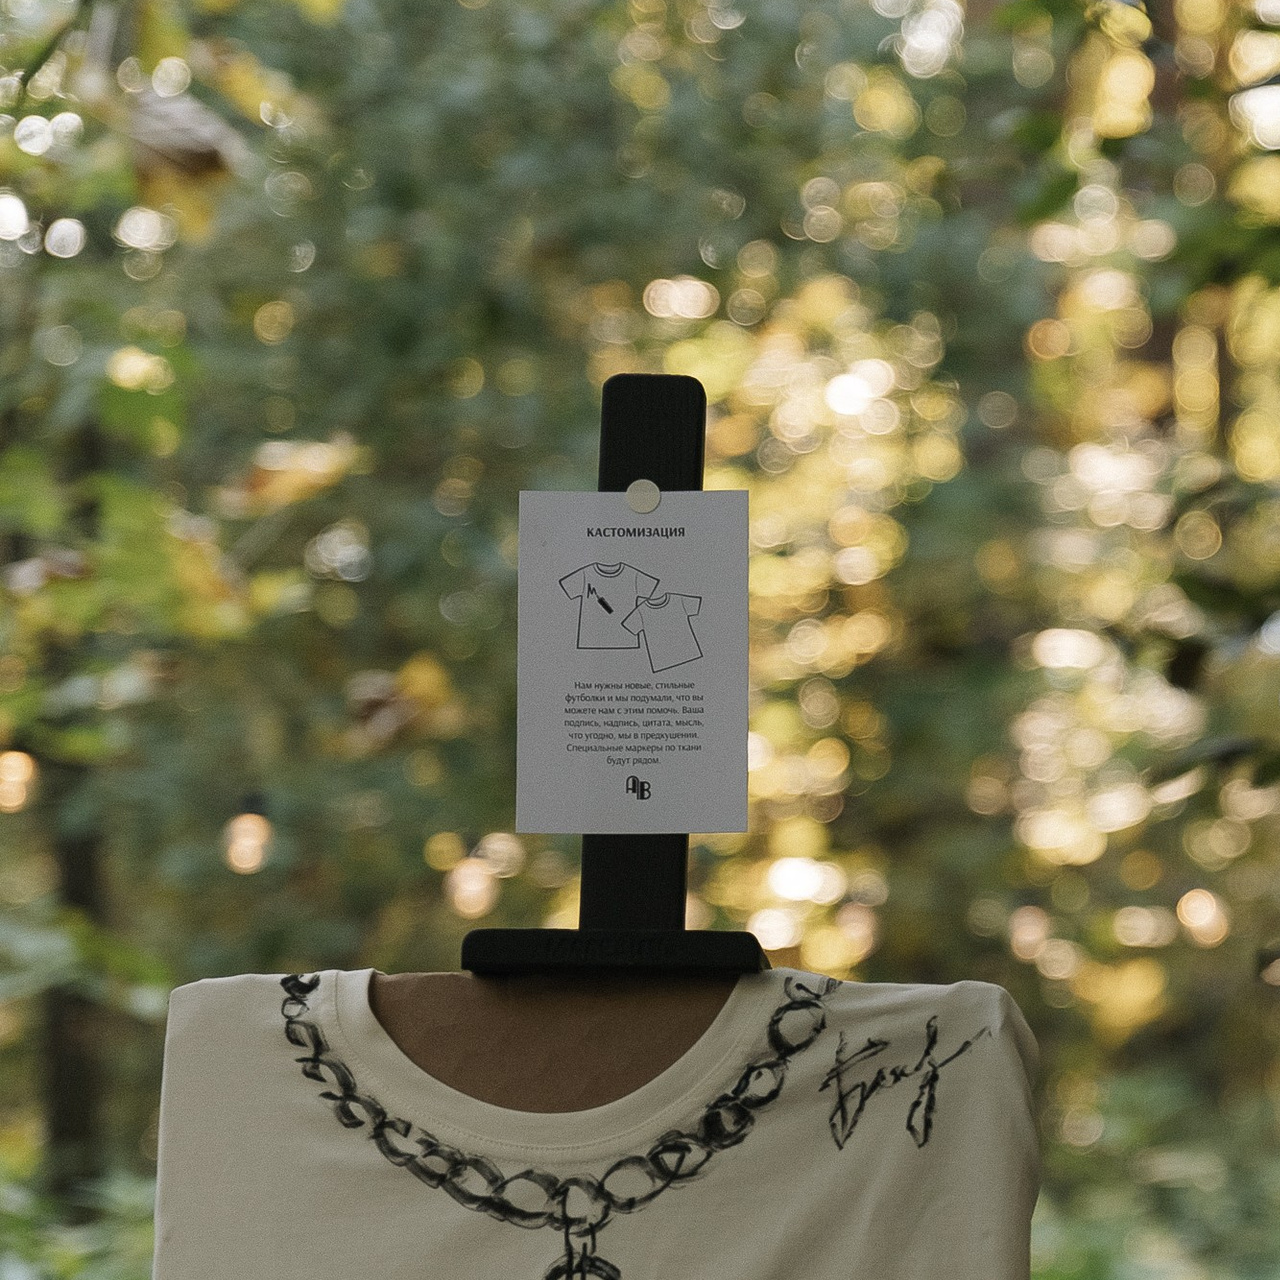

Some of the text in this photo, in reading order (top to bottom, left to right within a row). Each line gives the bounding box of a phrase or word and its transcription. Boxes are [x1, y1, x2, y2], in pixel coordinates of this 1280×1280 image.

[586, 526, 686, 539] КАСТОМИЗАЦИЯ
[574, 681, 592, 690] Нам
[594, 682, 623, 691] нужны
[655, 682, 695, 690] стильные
[564, 693, 606, 704] футболки
[682, 706, 704, 714] Ваша
[566, 744, 624, 753] Специальные
[625, 745, 663, 754] маркеры
[606, 756, 630, 766] будут
